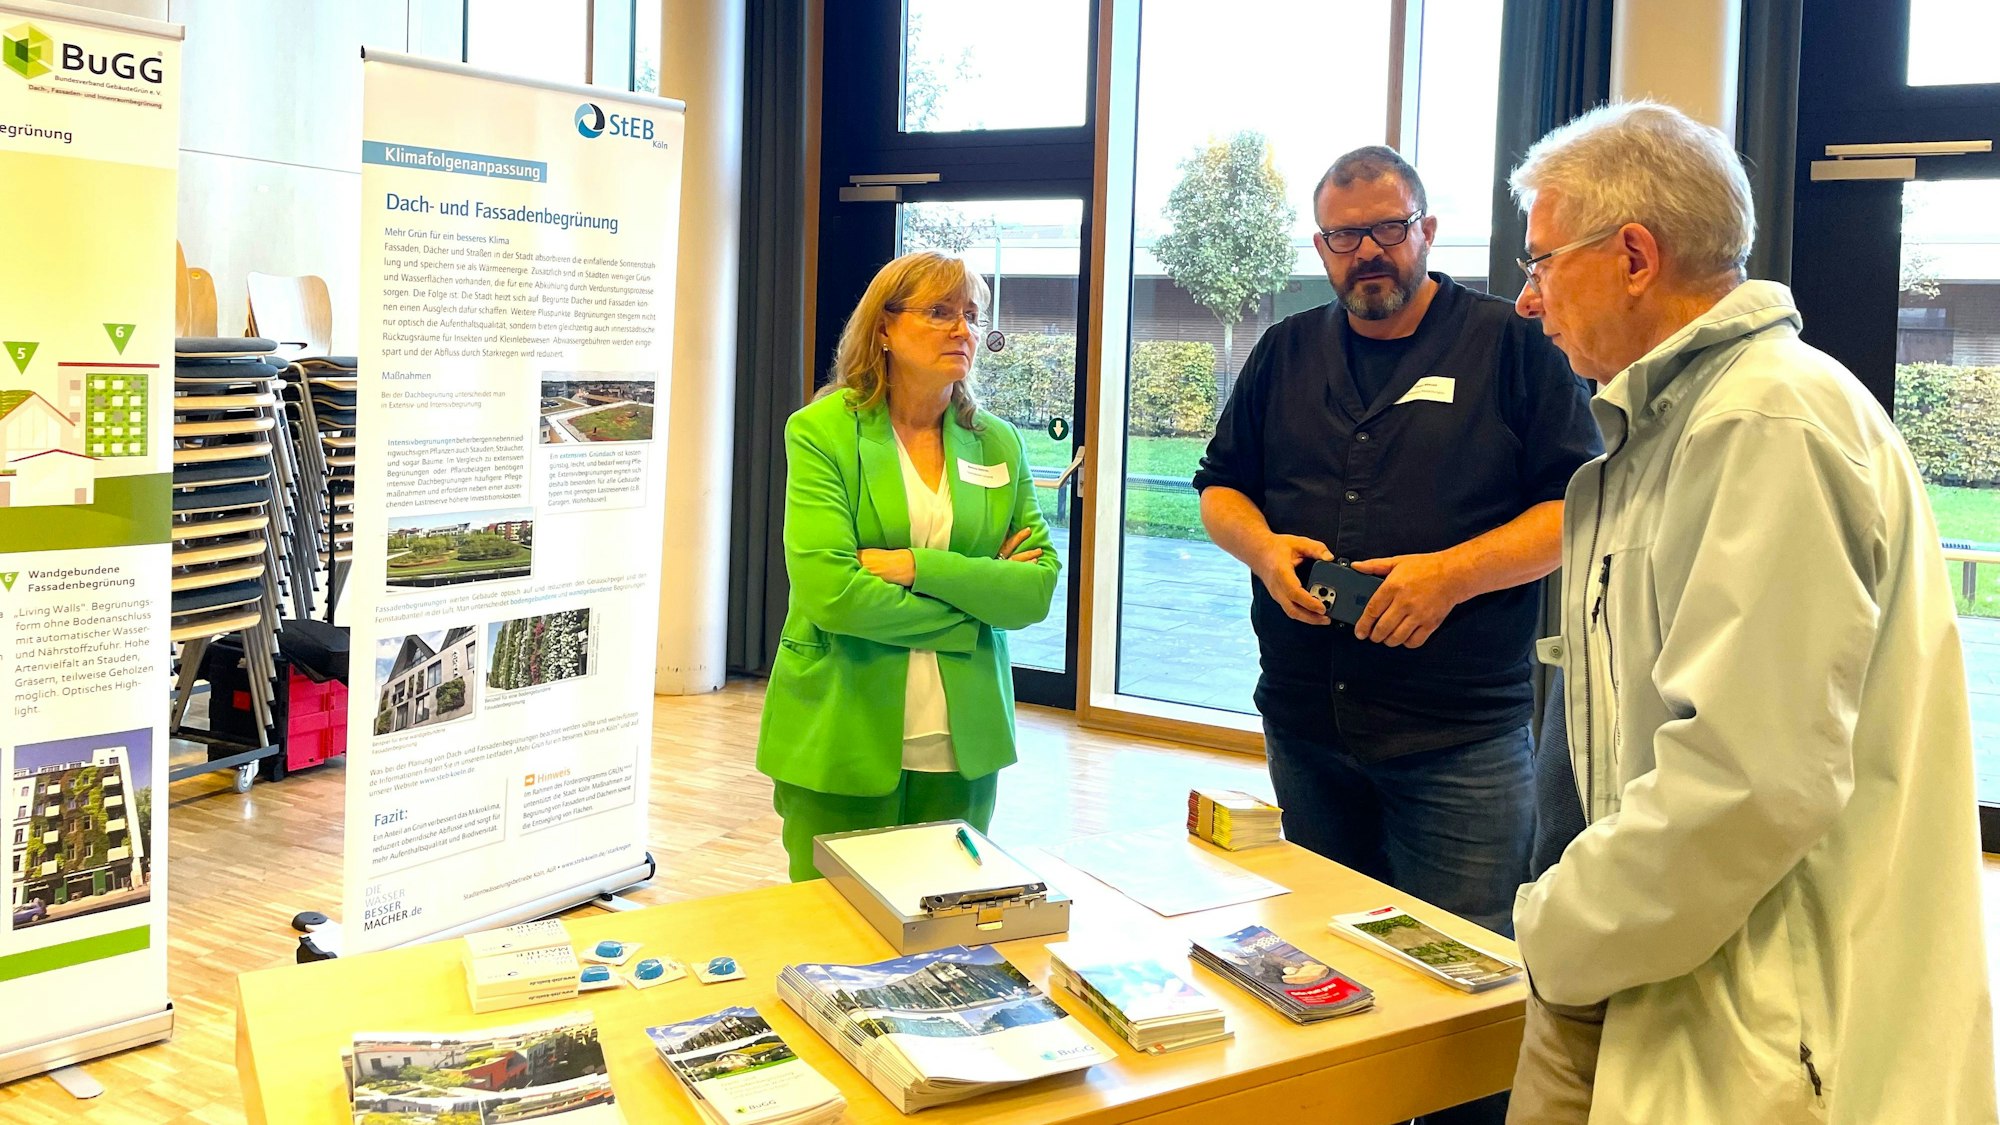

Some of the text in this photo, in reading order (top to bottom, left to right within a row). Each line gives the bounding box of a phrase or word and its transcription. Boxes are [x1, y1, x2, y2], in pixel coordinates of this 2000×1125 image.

[62, 43, 162, 83] BuGG
[55, 75, 104, 88] Bundesverband
[609, 115, 654, 141] StEB
[653, 140, 668, 150] Köln
[385, 147, 540, 181] Klimafolgenanpassung
[386, 193, 618, 234] Dach- und Fassadenbegrünung
[385, 228, 406, 236] Mehr
[408, 229, 427, 238] Grün
[430, 231, 440, 239] für
[457, 233, 486, 243] besseres
[489, 236, 509, 245] Klima
[385, 243, 420, 253] Fassaden,
[451, 248, 464, 256] und
[467, 248, 491, 258] Straßen
[503, 251, 513, 259] der
[516, 252, 533, 260] Stadt
[572, 256, 582, 264] die
[384, 258, 401, 268] lung
[420, 260, 454, 269] speichern
[468, 263, 477, 271] als
[384, 273, 398, 281] und
[455, 276, 492, 287] vorhanden,
[570, 283, 587, 291] durch
[384, 289, 410, 298] sorgen.
[413, 289, 425, 297] Die
[428, 290, 447, 300] Folge
[462, 291, 472, 299] Die
[475, 292, 492, 300] Stadt
[495, 293, 511, 301] heizt
[513, 293, 526, 302] sich
[609, 298, 635, 307] Fassaden
[400, 304, 420, 312] einen
[423, 304, 456, 314] Ausgleich
[510, 308, 536, 316] Weitere
[116, 326, 124, 338] 6
[398, 319, 424, 327] optisch
[427, 319, 438, 327] die
[510, 320, 536, 330] sondern
[454, 334, 482, 342] Insekten
[17, 348, 25, 359] 5
[382, 348, 401, 357] spart
[404, 348, 418, 356] und
[421, 348, 432, 356] der
[434, 348, 459, 356] Abfluss
[462, 348, 480, 356] durch
[482, 349, 518, 359] Starkregen
[382, 372, 431, 380] Maßnahmen
[5, 566, 120, 582] 6 Wandgebundene
[29, 578, 135, 592] Fassadenbegrünung
[16, 612, 151, 631] form ohne Bodenanschluss
[16, 626, 149, 645] mit automatischer Wasser-
[16, 650, 34, 659] und
[125, 639, 149, 648] Hohe
[15, 660, 79, 673] Artenvielfalt
[97, 654, 140, 664] Stauden,
[62, 671, 106, 682] teilweise
[62, 684, 112, 697] Optisches
[115, 680, 141, 691] High-
[15, 705, 40, 717] light.
[370, 768, 383, 776] Was
[385, 765, 394, 773] bei
[396, 762, 406, 770] der
[408, 758, 432, 768] Planung
[538, 768, 570, 783] Hinweis
[375, 809, 408, 826] Fazit:
[385, 829, 402, 838] Anteil
[428, 814, 456, 826] verbessert
[458, 811, 467, 819] das
[373, 841, 399, 853] reduziert
[465, 820, 475, 828] und
[477, 817, 491, 826] sorgt
[372, 855, 388, 864] mehr
[449, 834, 460, 843] und
[365, 889, 405, 908] WASSER
[366, 884, 382, 896] DIE
[364, 906, 422, 931] MACHER.de
[365, 901, 400, 919] BESSER
